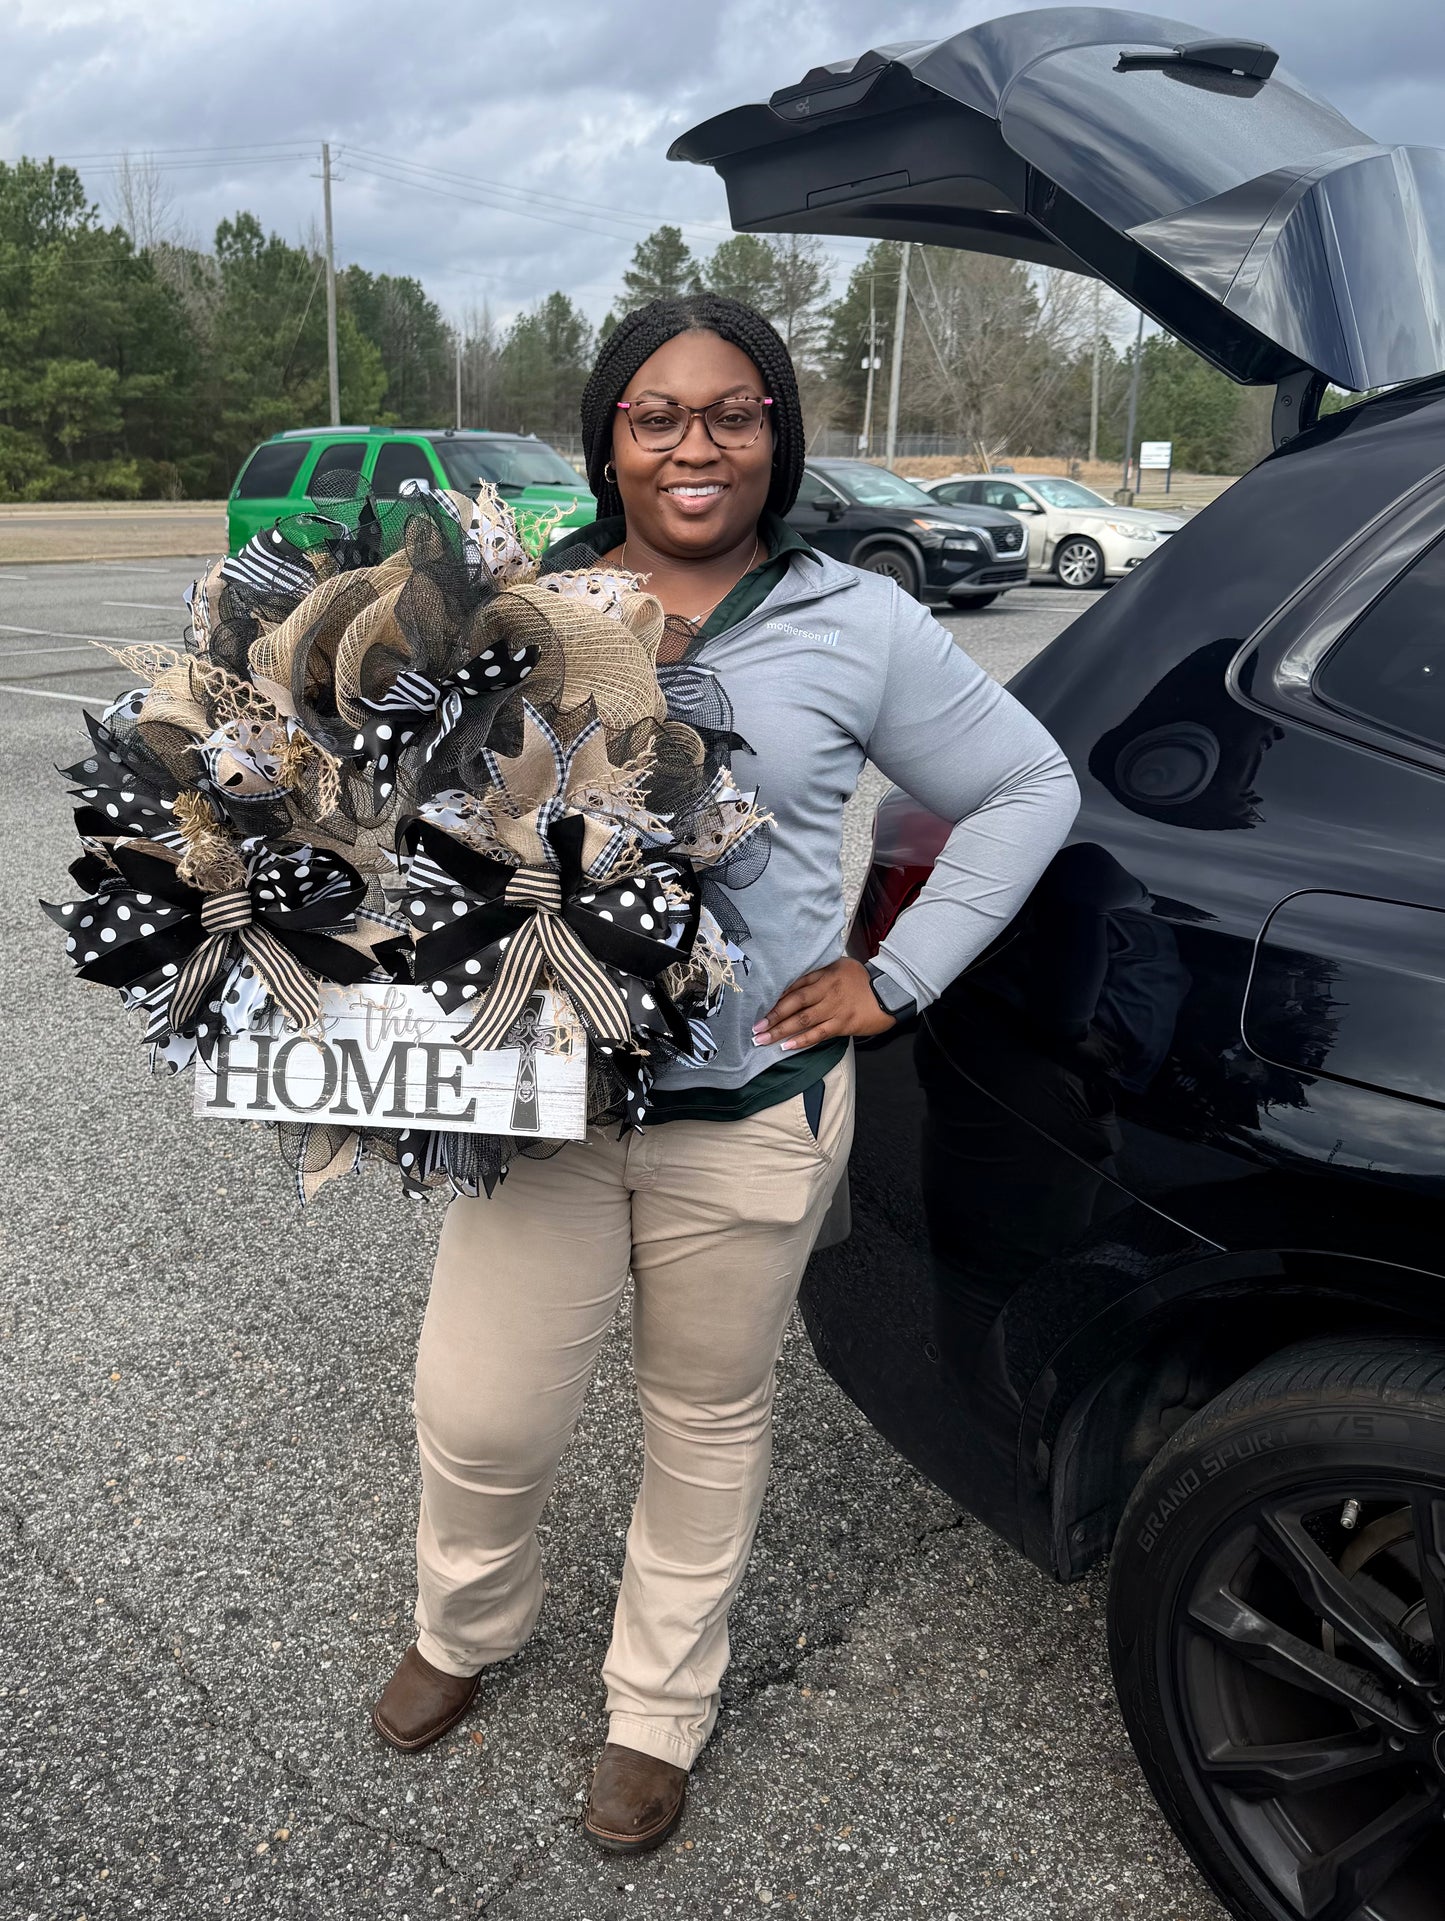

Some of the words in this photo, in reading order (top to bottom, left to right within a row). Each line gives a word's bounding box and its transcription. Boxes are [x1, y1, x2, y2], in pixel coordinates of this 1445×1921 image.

[766, 621, 821, 641] motherson
[206, 1034, 477, 1122] HOME
[1137, 1468, 1200, 1553] GRAND
[1307, 1414, 1376, 1440] A/S
